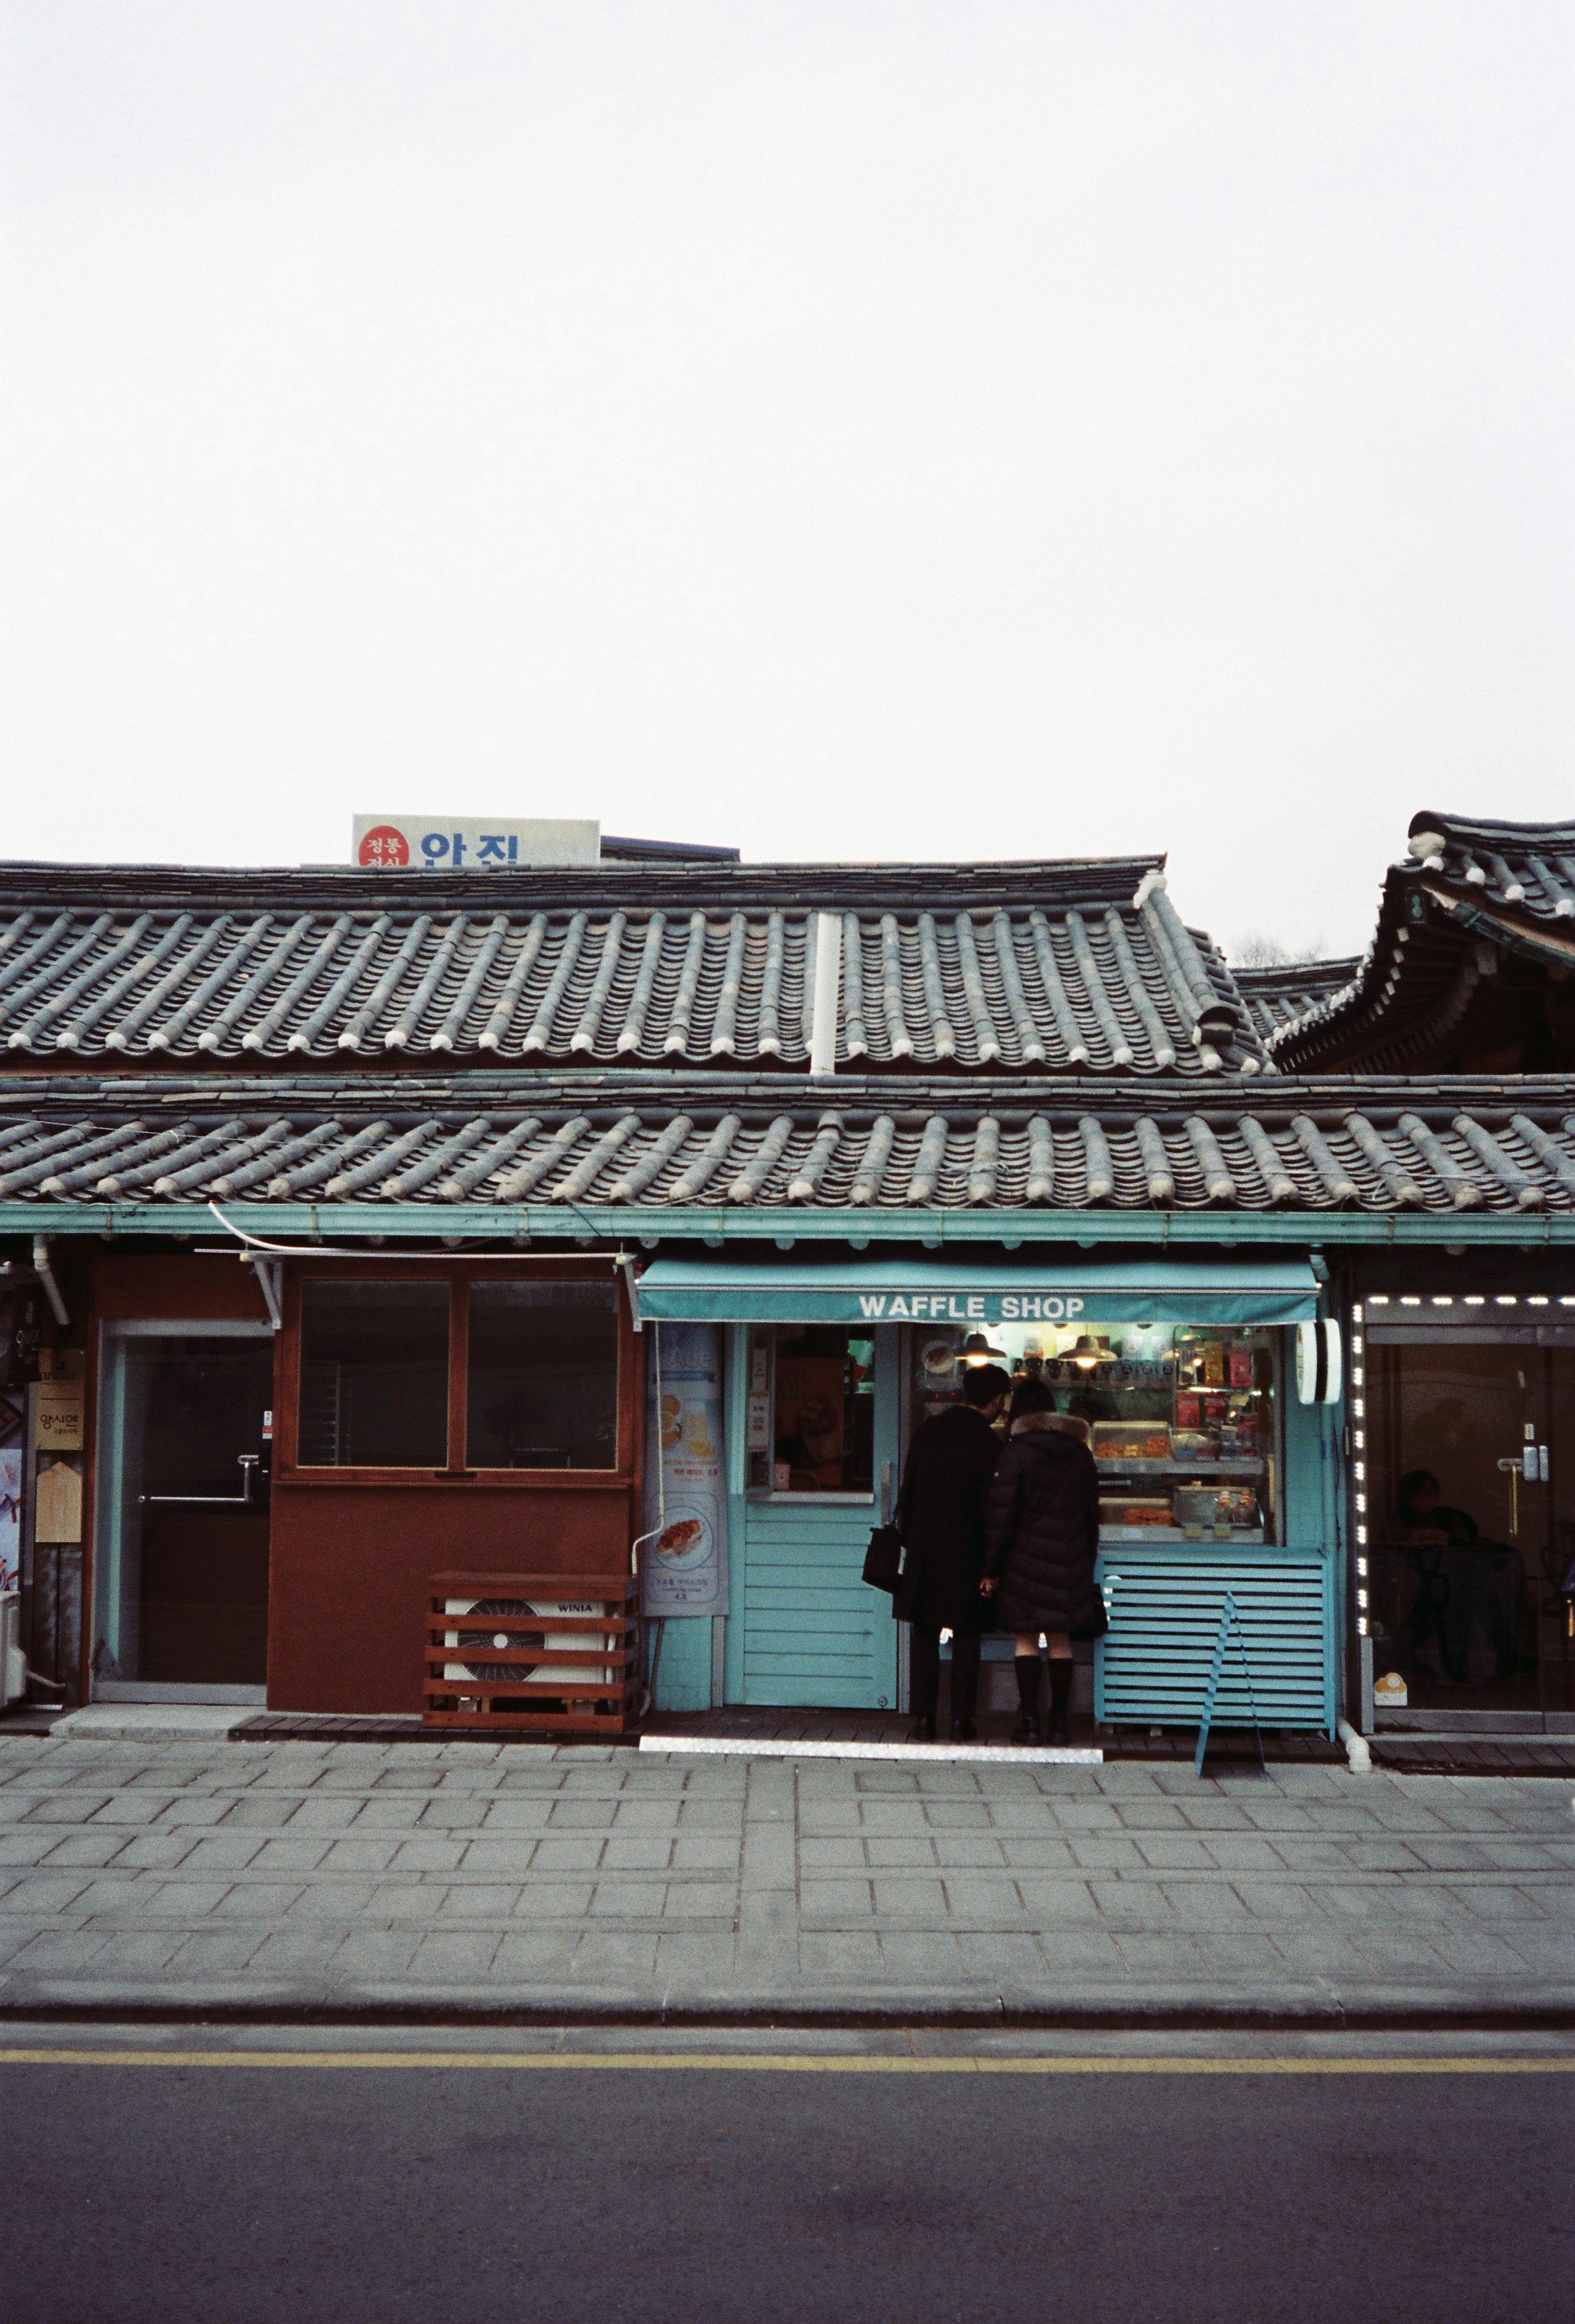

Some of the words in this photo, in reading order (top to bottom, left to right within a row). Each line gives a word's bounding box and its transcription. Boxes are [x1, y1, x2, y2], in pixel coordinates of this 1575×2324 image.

[367, 837, 402, 854] 정통
[859, 1295, 985, 1318] WAFFLE
[1000, 1296, 1085, 1318] SHOP
[558, 1604, 593, 1613] WINIA
